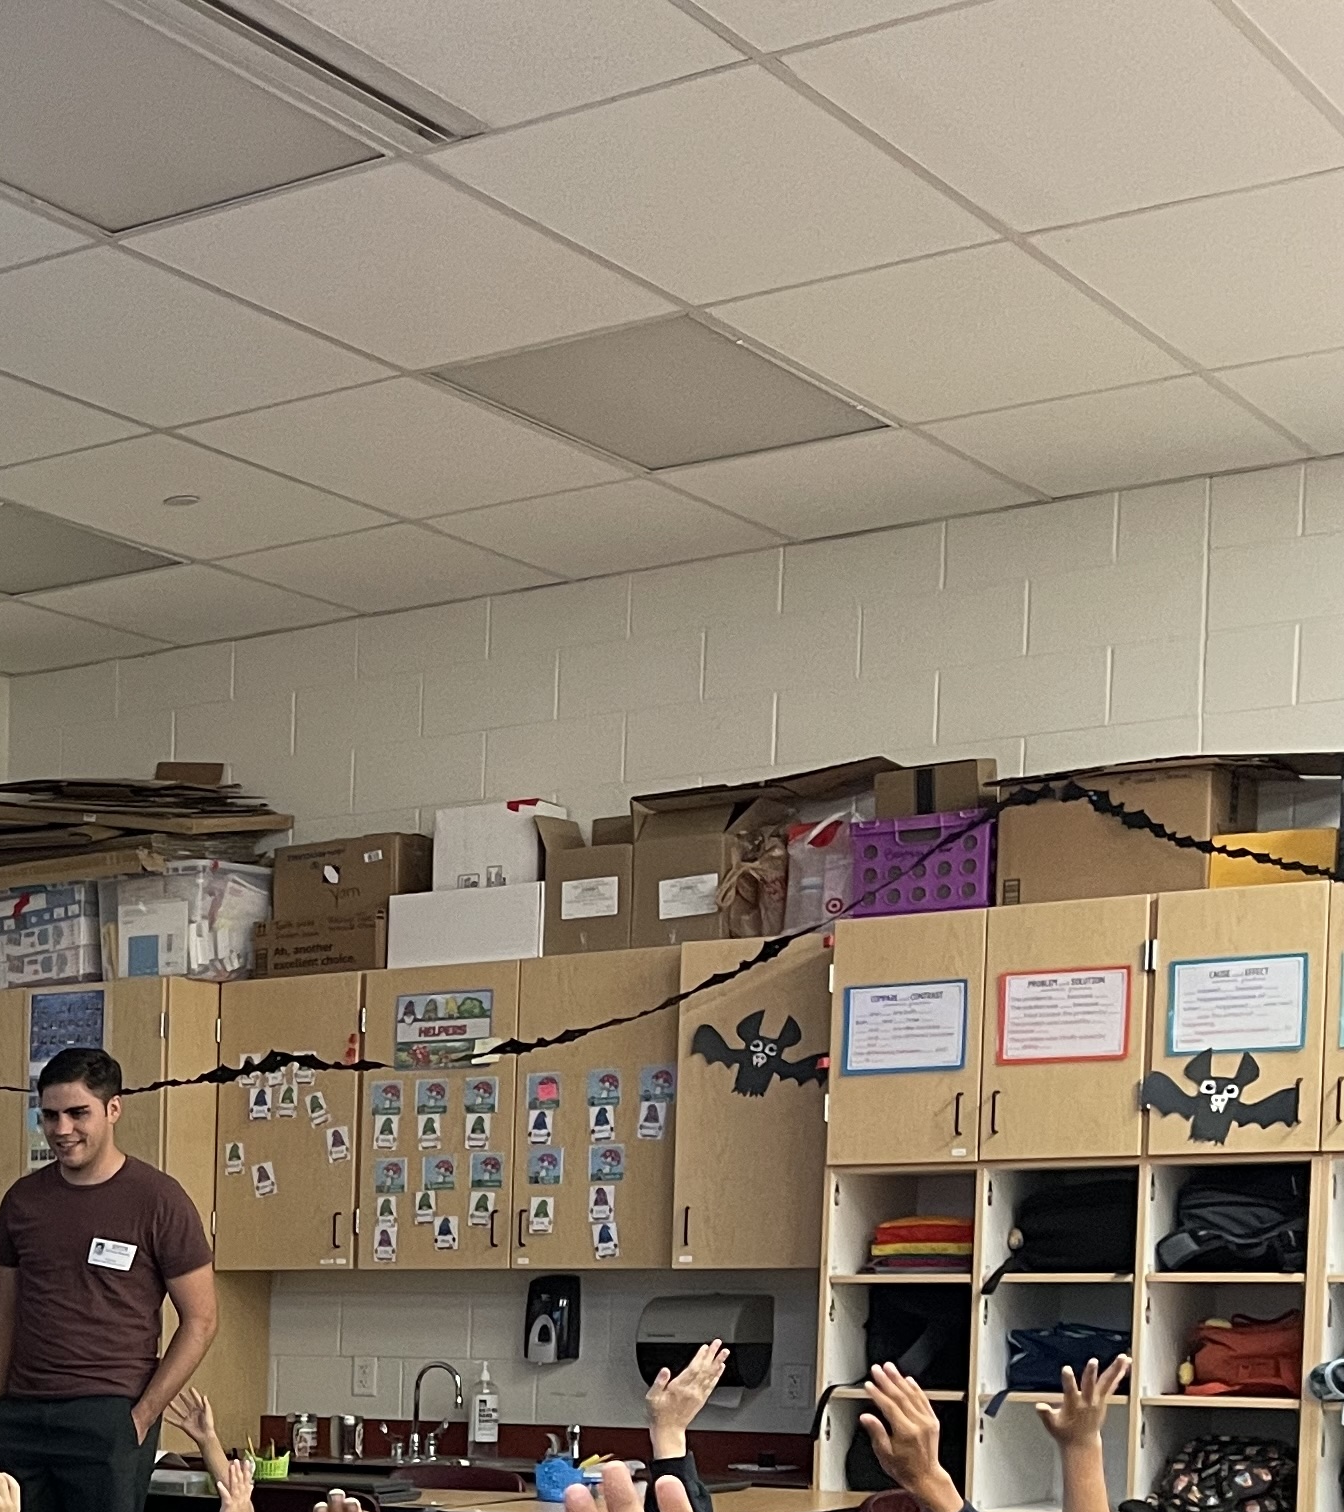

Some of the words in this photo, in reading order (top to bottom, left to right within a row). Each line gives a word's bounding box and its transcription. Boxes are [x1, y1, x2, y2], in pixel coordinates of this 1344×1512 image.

[292, 943, 333, 954] another
[1244, 967, 1269, 976] EFFECT
[418, 1024, 467, 1038] HELPERS
